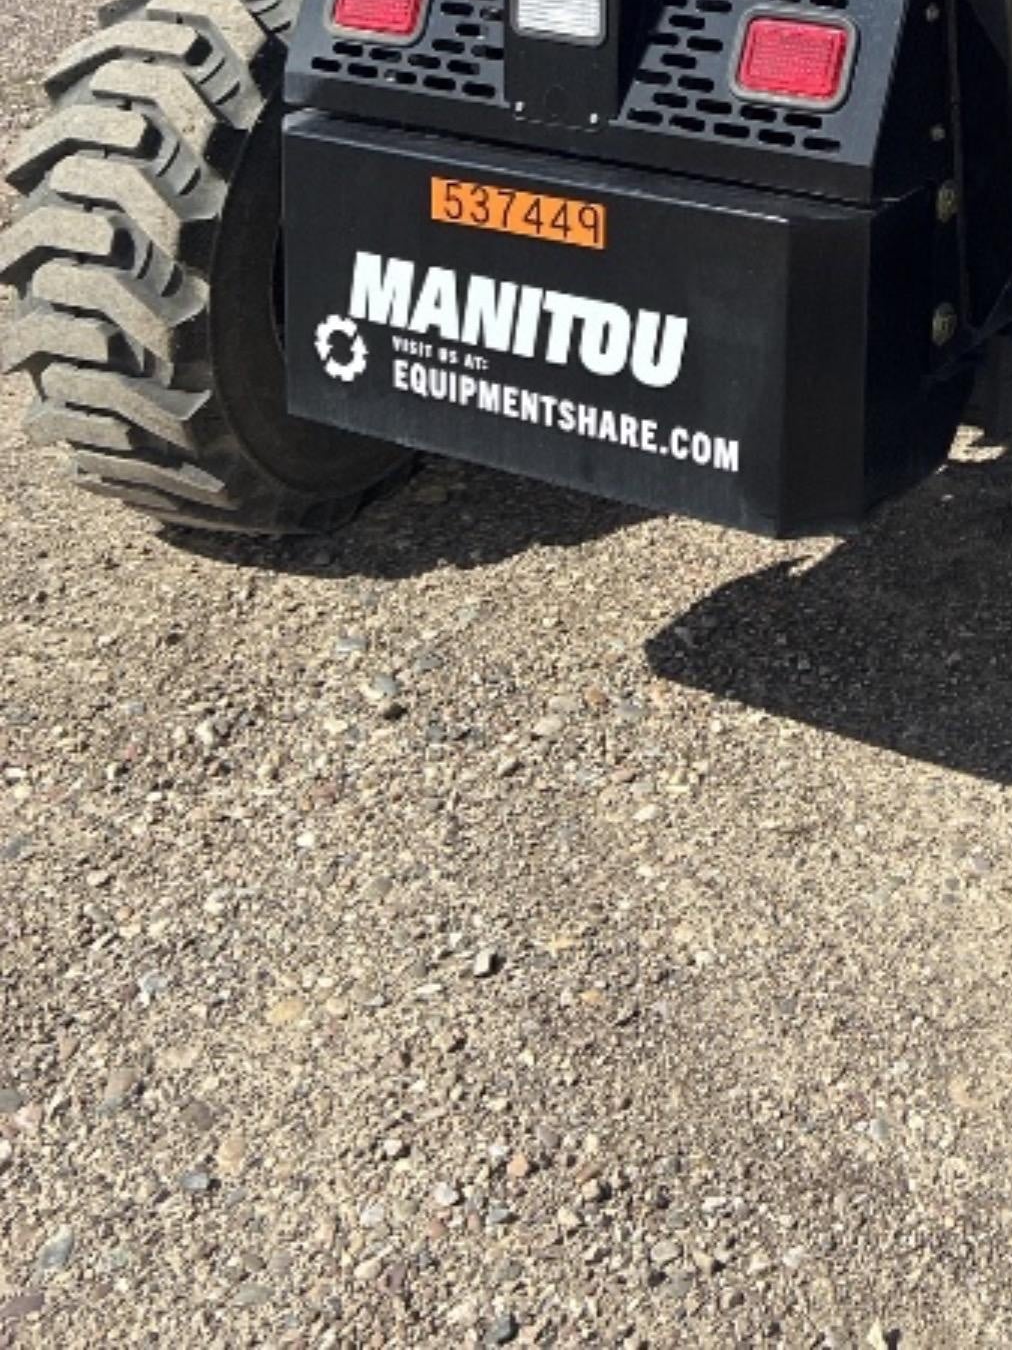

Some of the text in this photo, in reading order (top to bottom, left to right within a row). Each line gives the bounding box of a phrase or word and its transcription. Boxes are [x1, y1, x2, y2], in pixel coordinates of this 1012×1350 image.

[444, 181, 601, 244] 537449
[349, 250, 689, 388] MANITOU
[392, 335, 489, 370] VISIT US AT:
[392, 359, 740, 472] EQUIPMENTSHARE.COM
